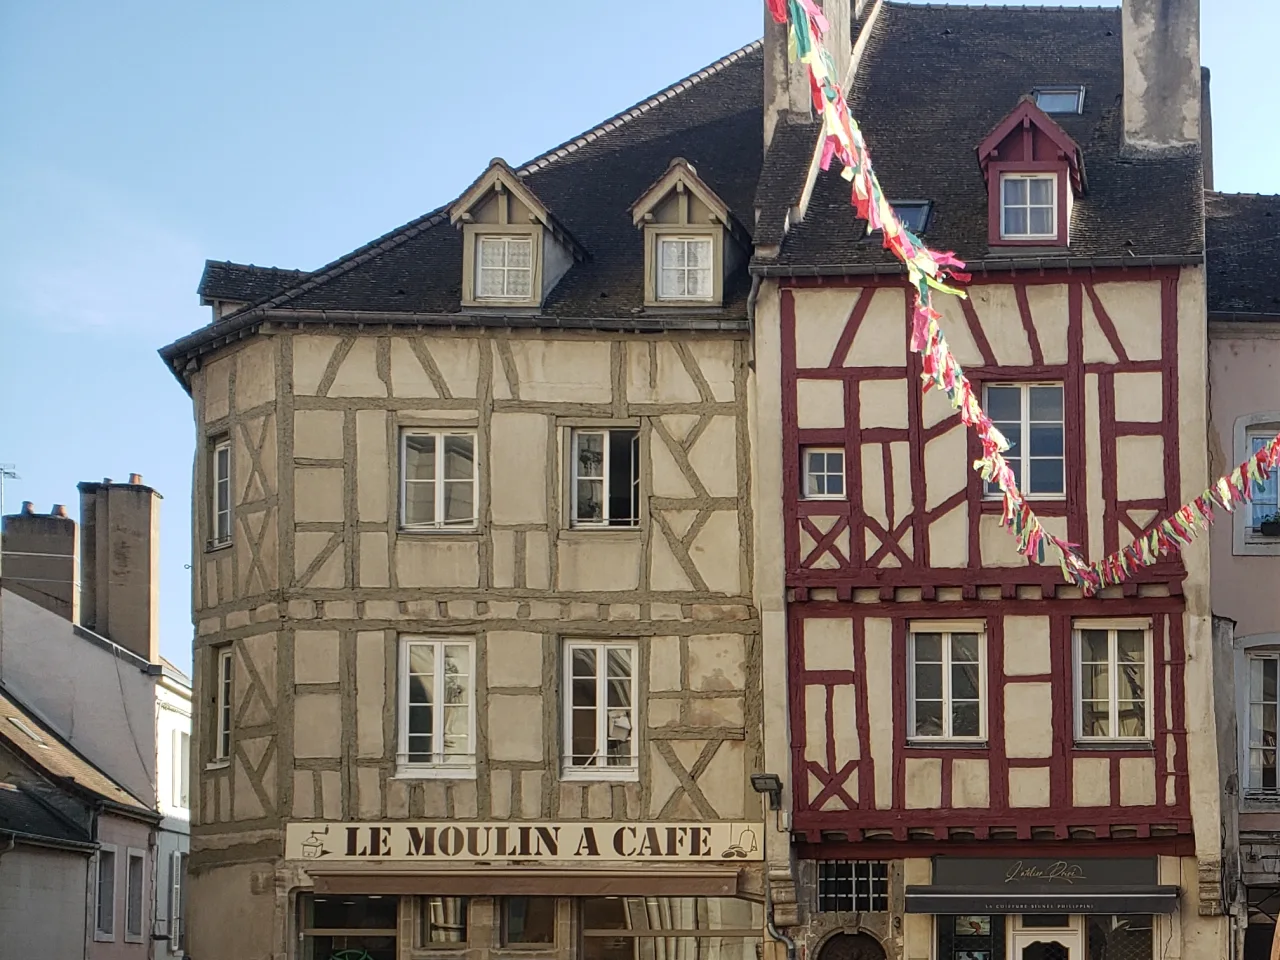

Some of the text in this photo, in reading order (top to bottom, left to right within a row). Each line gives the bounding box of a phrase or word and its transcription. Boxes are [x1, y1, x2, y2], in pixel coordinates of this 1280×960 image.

[345, 826, 712, 857] LE MOULIN A CAFE
[893, 916, 901, 929] 3
